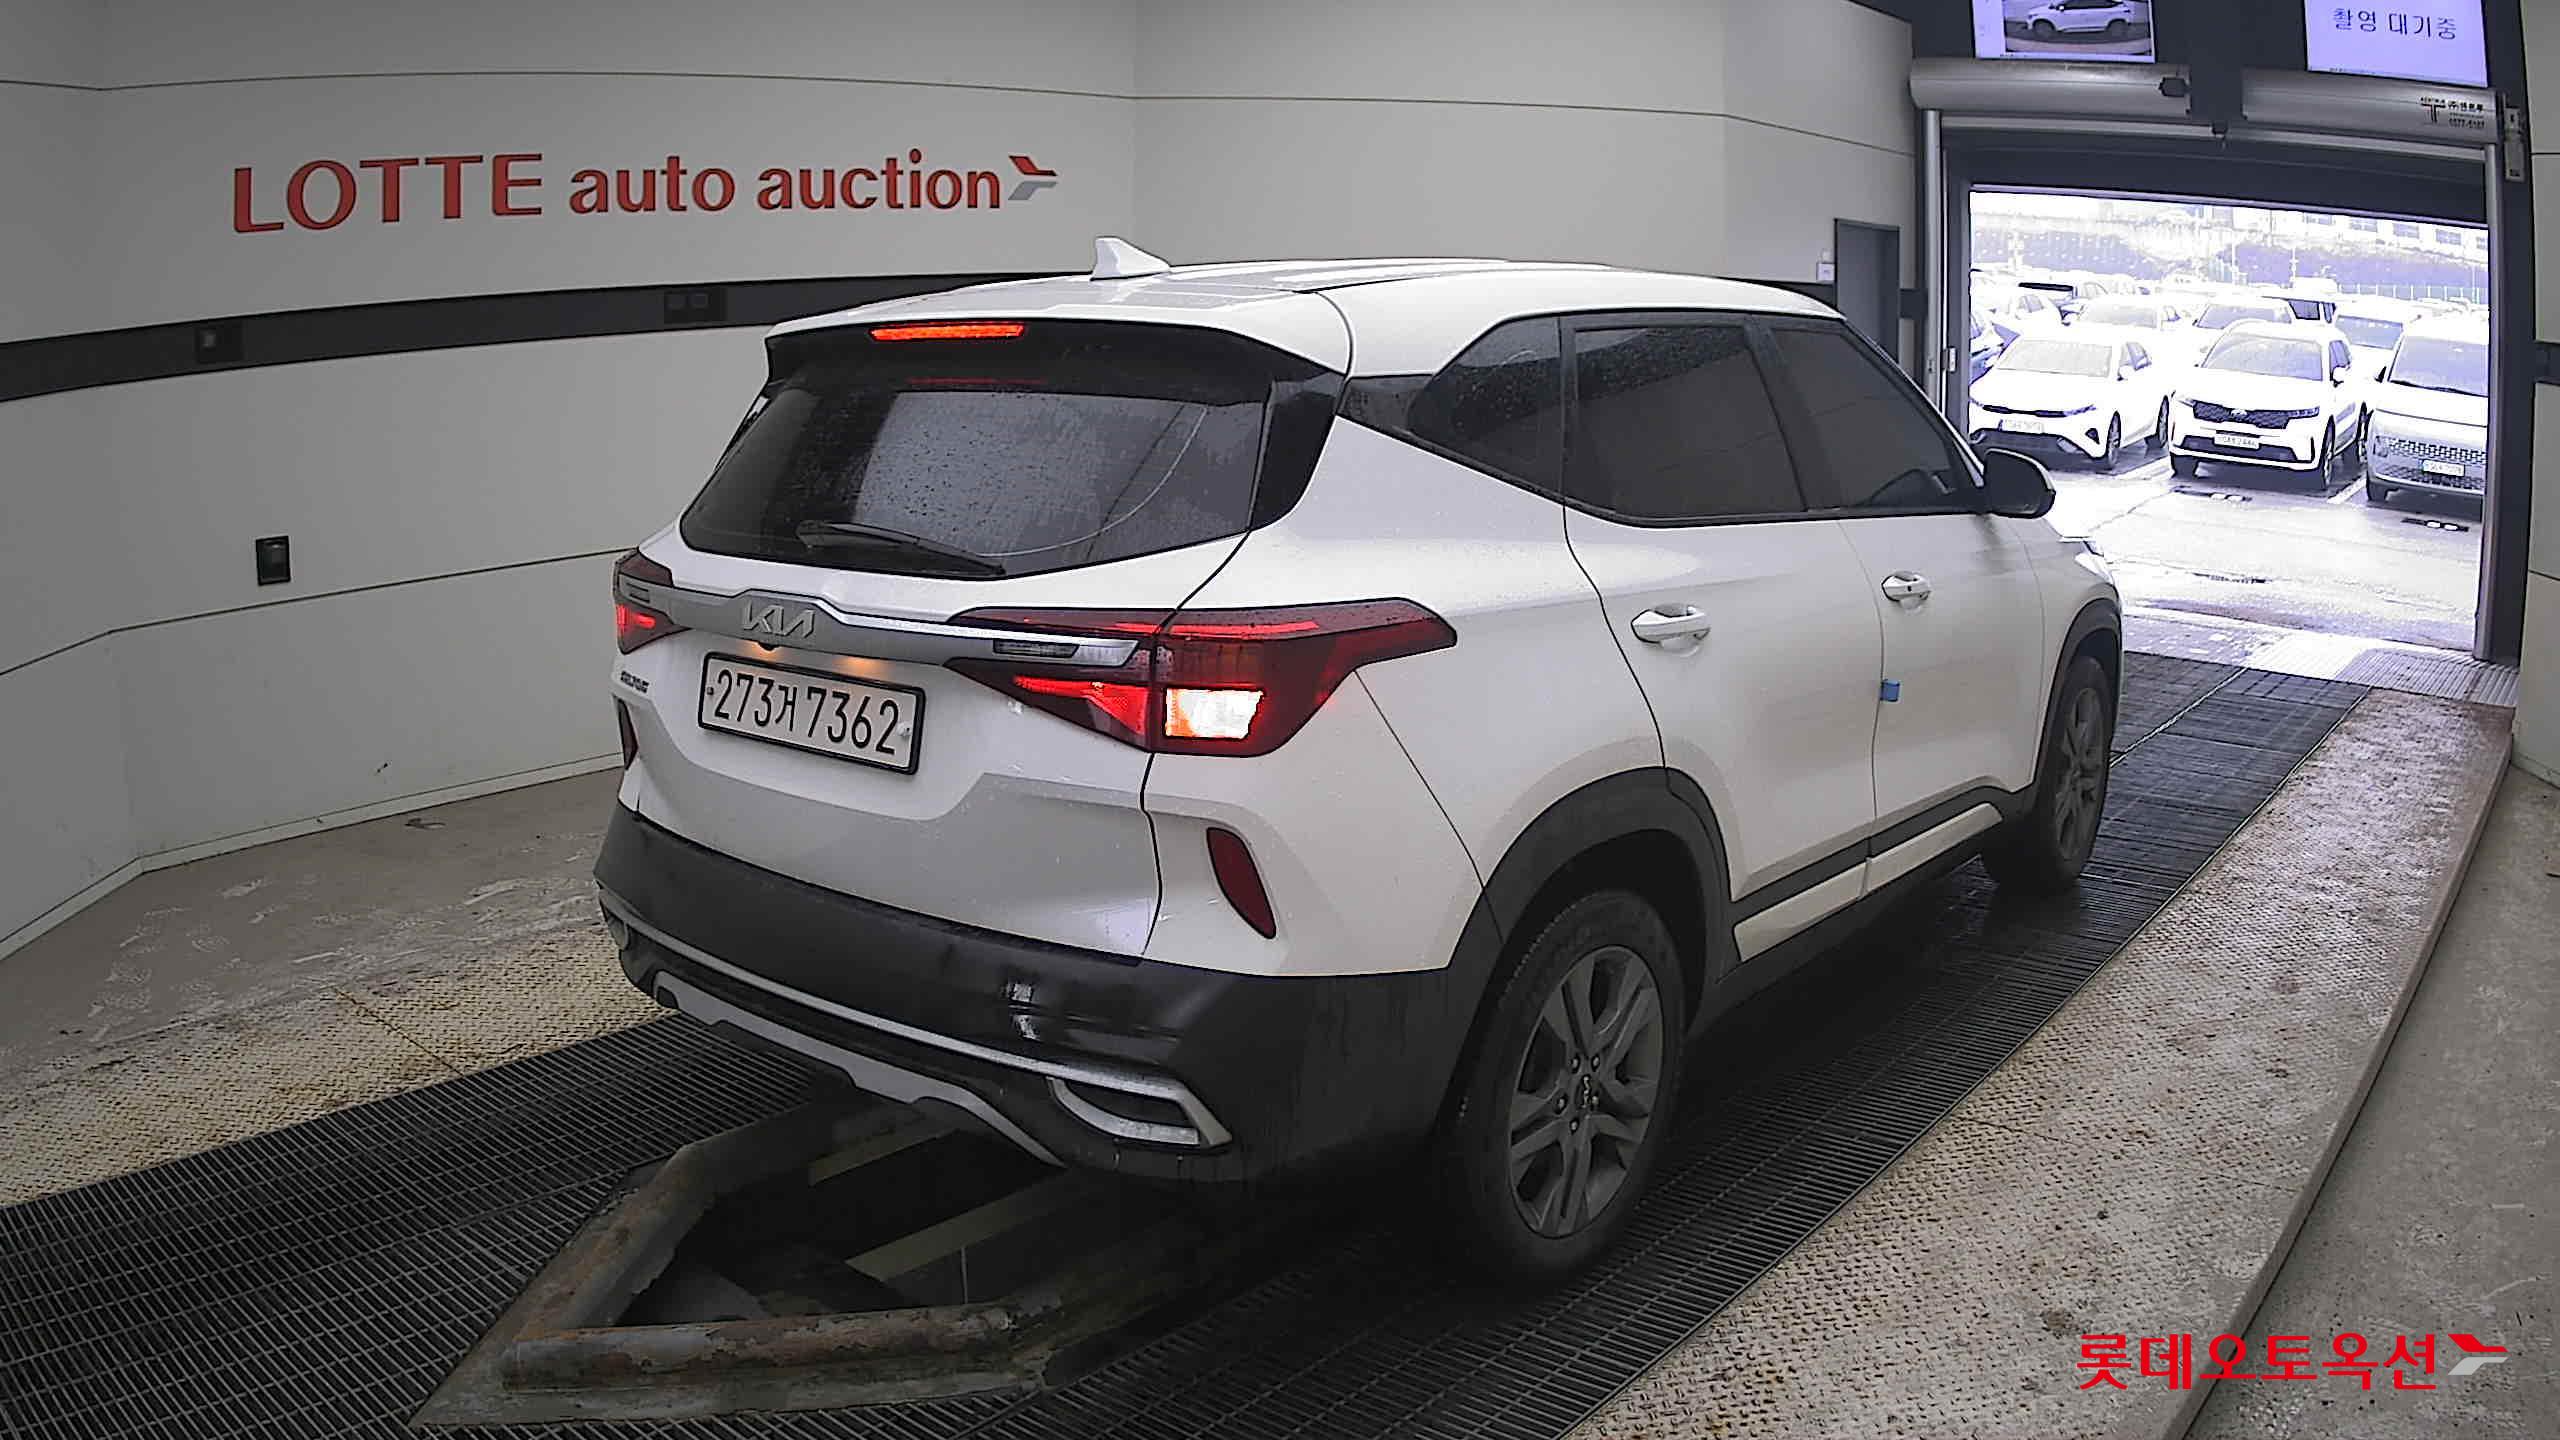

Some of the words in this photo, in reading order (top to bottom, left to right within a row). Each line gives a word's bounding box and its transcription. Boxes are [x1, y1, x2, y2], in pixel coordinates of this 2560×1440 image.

[2333, 8, 2377, 33] 촬영
[2388, 12, 2458, 41] 대기중
[233, 152, 543, 233] LOTTE
[569, 155, 737, 215] auto
[756, 148, 1002, 212] auction
